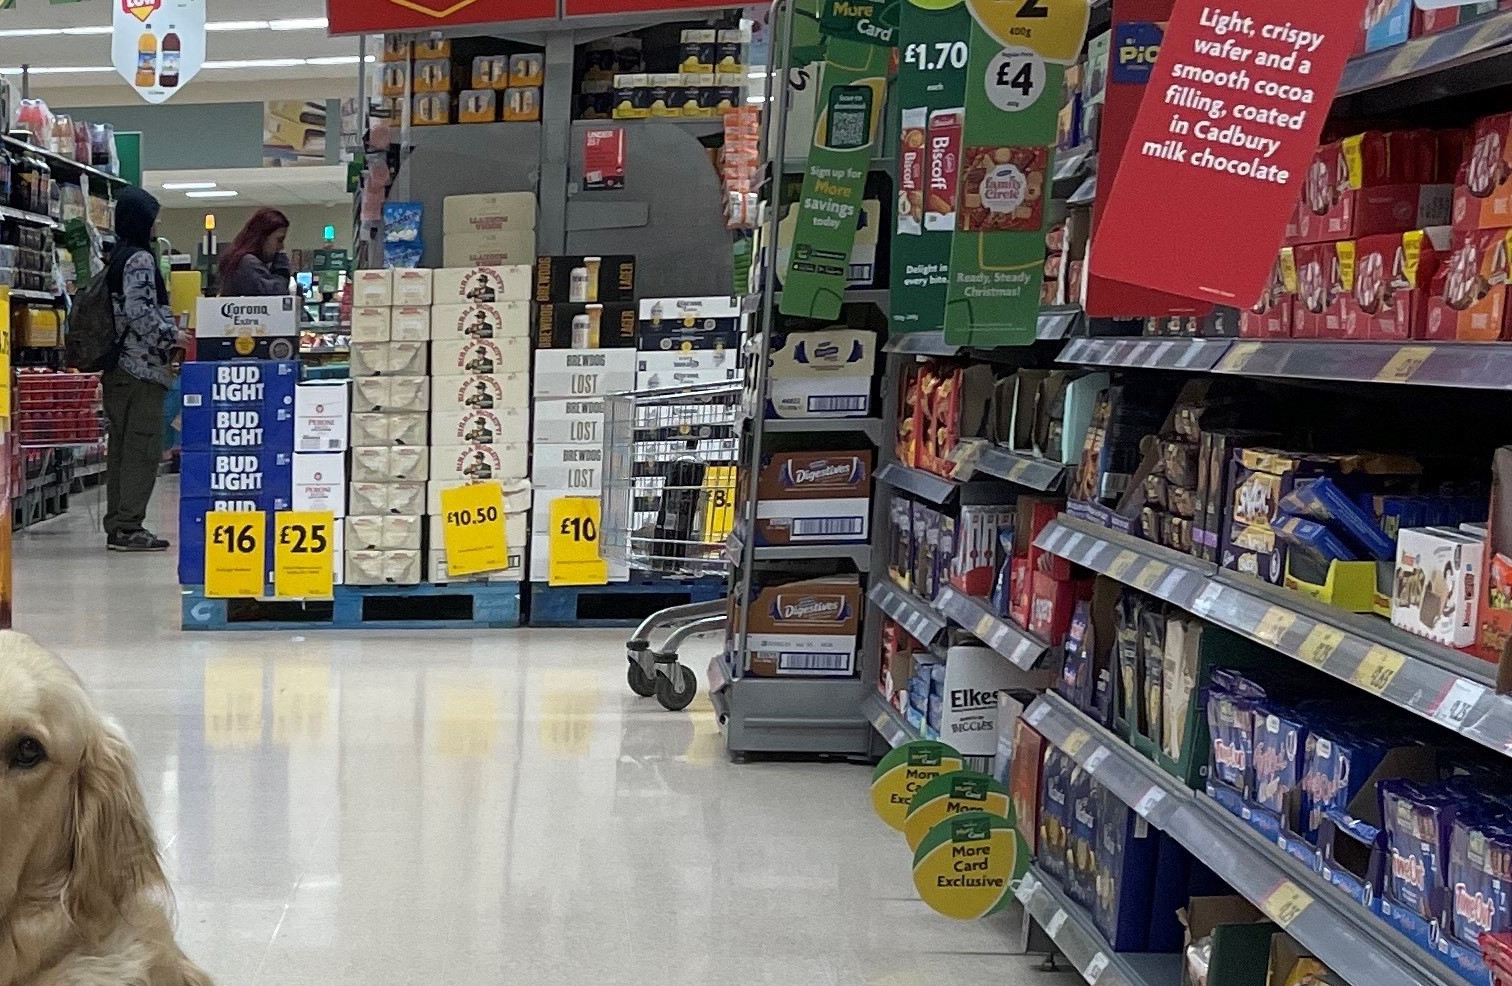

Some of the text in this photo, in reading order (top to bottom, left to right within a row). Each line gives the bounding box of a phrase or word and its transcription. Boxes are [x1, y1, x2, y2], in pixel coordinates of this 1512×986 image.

[833, 2, 873, 18] More
[856, 19, 893, 41] Card
[1200, 7, 1325, 51] Light, crispy
[904, 41, 968, 70] £1.70
[1194, 38, 1312, 74] wafer and a
[996, 61, 1034, 96] £4
[1172, 62, 1315, 104] smooth cocoa
[1164, 84, 1307, 130] filling, coated
[1169, 114, 1281, 158] in Cadbury
[903, 152, 917, 189] Biscoff
[931, 136, 950, 190] Biscoff
[1141, 140, 1290, 184] milk chocolate
[809, 166, 862, 179] Sign up for
[814, 180, 852, 197] More
[804, 197, 855, 217] savings
[813, 216, 841, 230] today
[618, 262, 634, 290] LAGER
[906, 264, 938, 276] Delight
[221, 302, 270, 319] Corona
[233, 317, 260, 326] Extra
[620, 310, 635, 338] LAGER
[566, 354, 606, 367] BREWDOG
[217, 366, 261, 384] BUD
[571, 374, 598, 394] LOST
[212, 384, 265, 402] LIGHT
[216, 411, 260, 429] BUD
[211, 429, 264, 446] LIGHT
[570, 421, 597, 441] LOST
[216, 455, 259, 473] BUD
[563, 449, 602, 462] BREWDOG
[211, 472, 263, 491] LIGHT
[567, 468, 595, 488] LOST
[795, 463, 850, 483] Digestives
[447, 506, 498, 527] £10.50
[212, 525, 257, 553] £16
[280, 524, 327, 553] £25
[560, 517, 596, 542] £10
[784, 601, 838, 618] Digestives
[951, 688, 999, 709] Elkes
[952, 845, 991, 859] More
[953, 857, 988, 873] Card
[937, 875, 1003, 888] Exclusive
